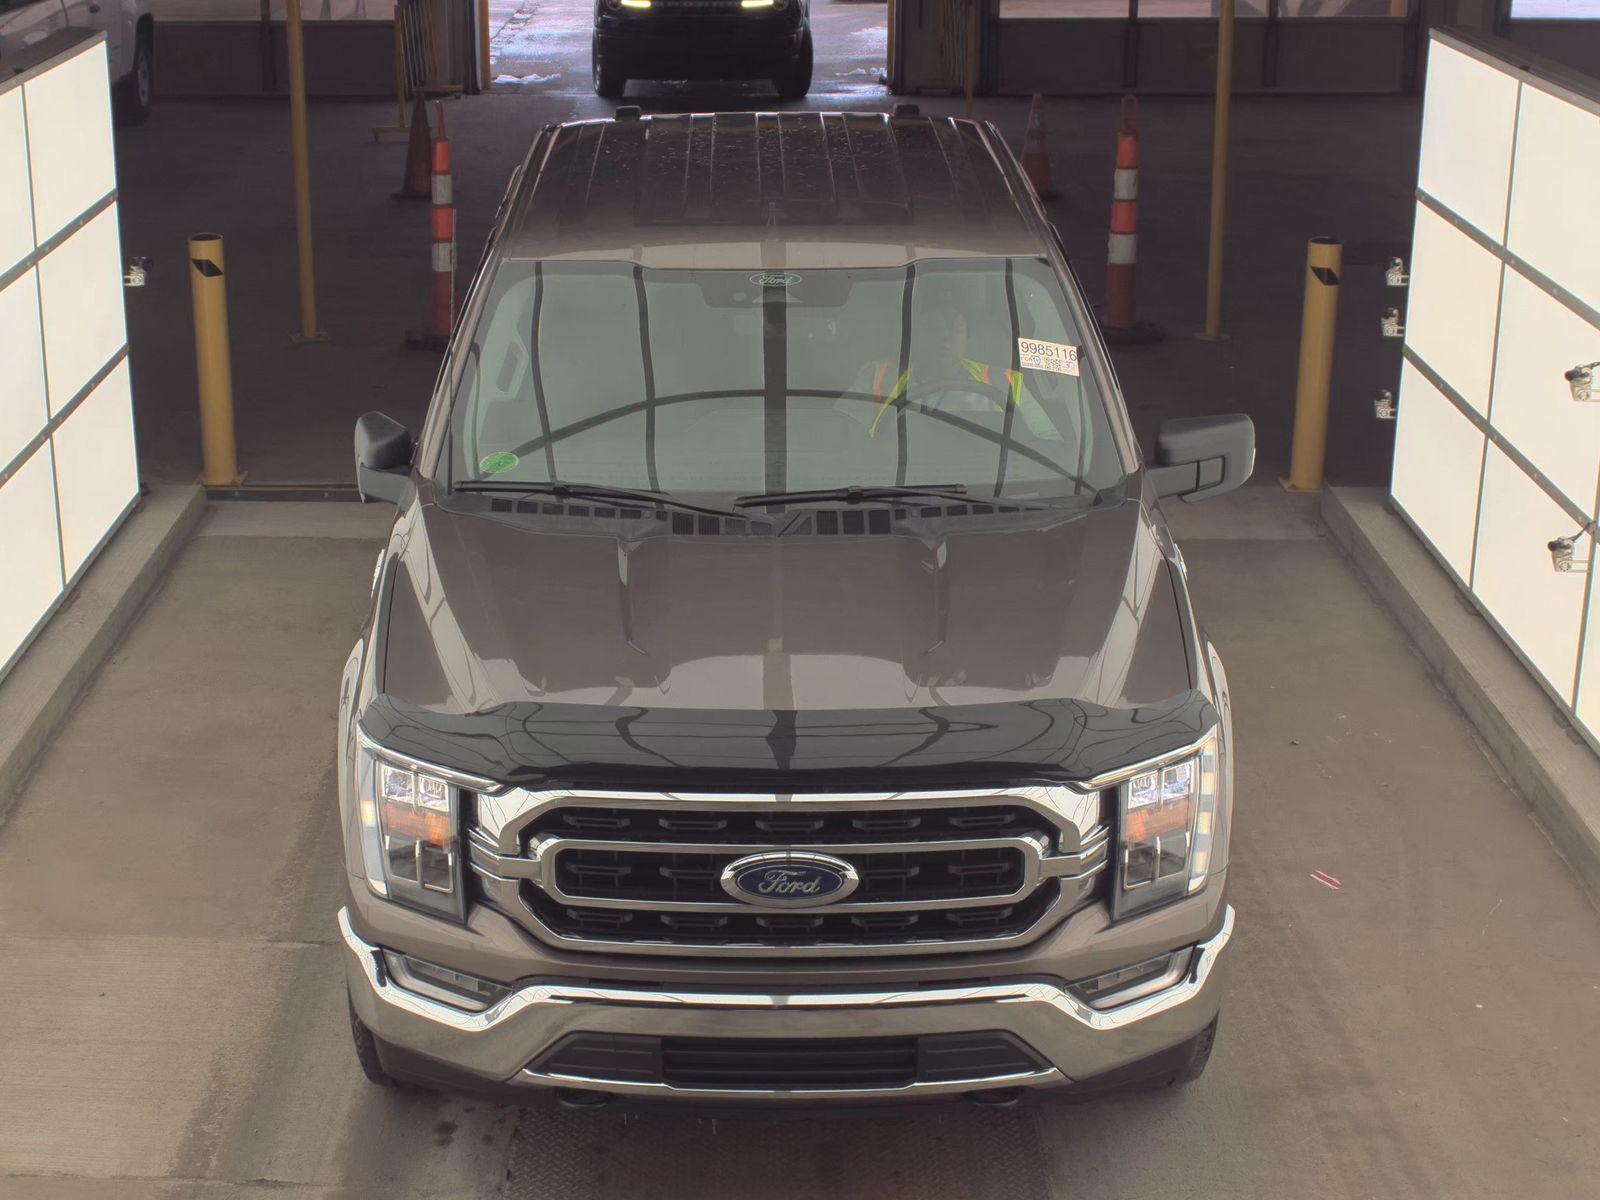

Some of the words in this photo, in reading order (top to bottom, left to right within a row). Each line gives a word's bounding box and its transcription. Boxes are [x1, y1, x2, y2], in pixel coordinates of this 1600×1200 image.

[759, 275, 793, 284] Ford
[1021, 341, 1077, 361] 9985116
[758, 869, 821, 894] Ford
